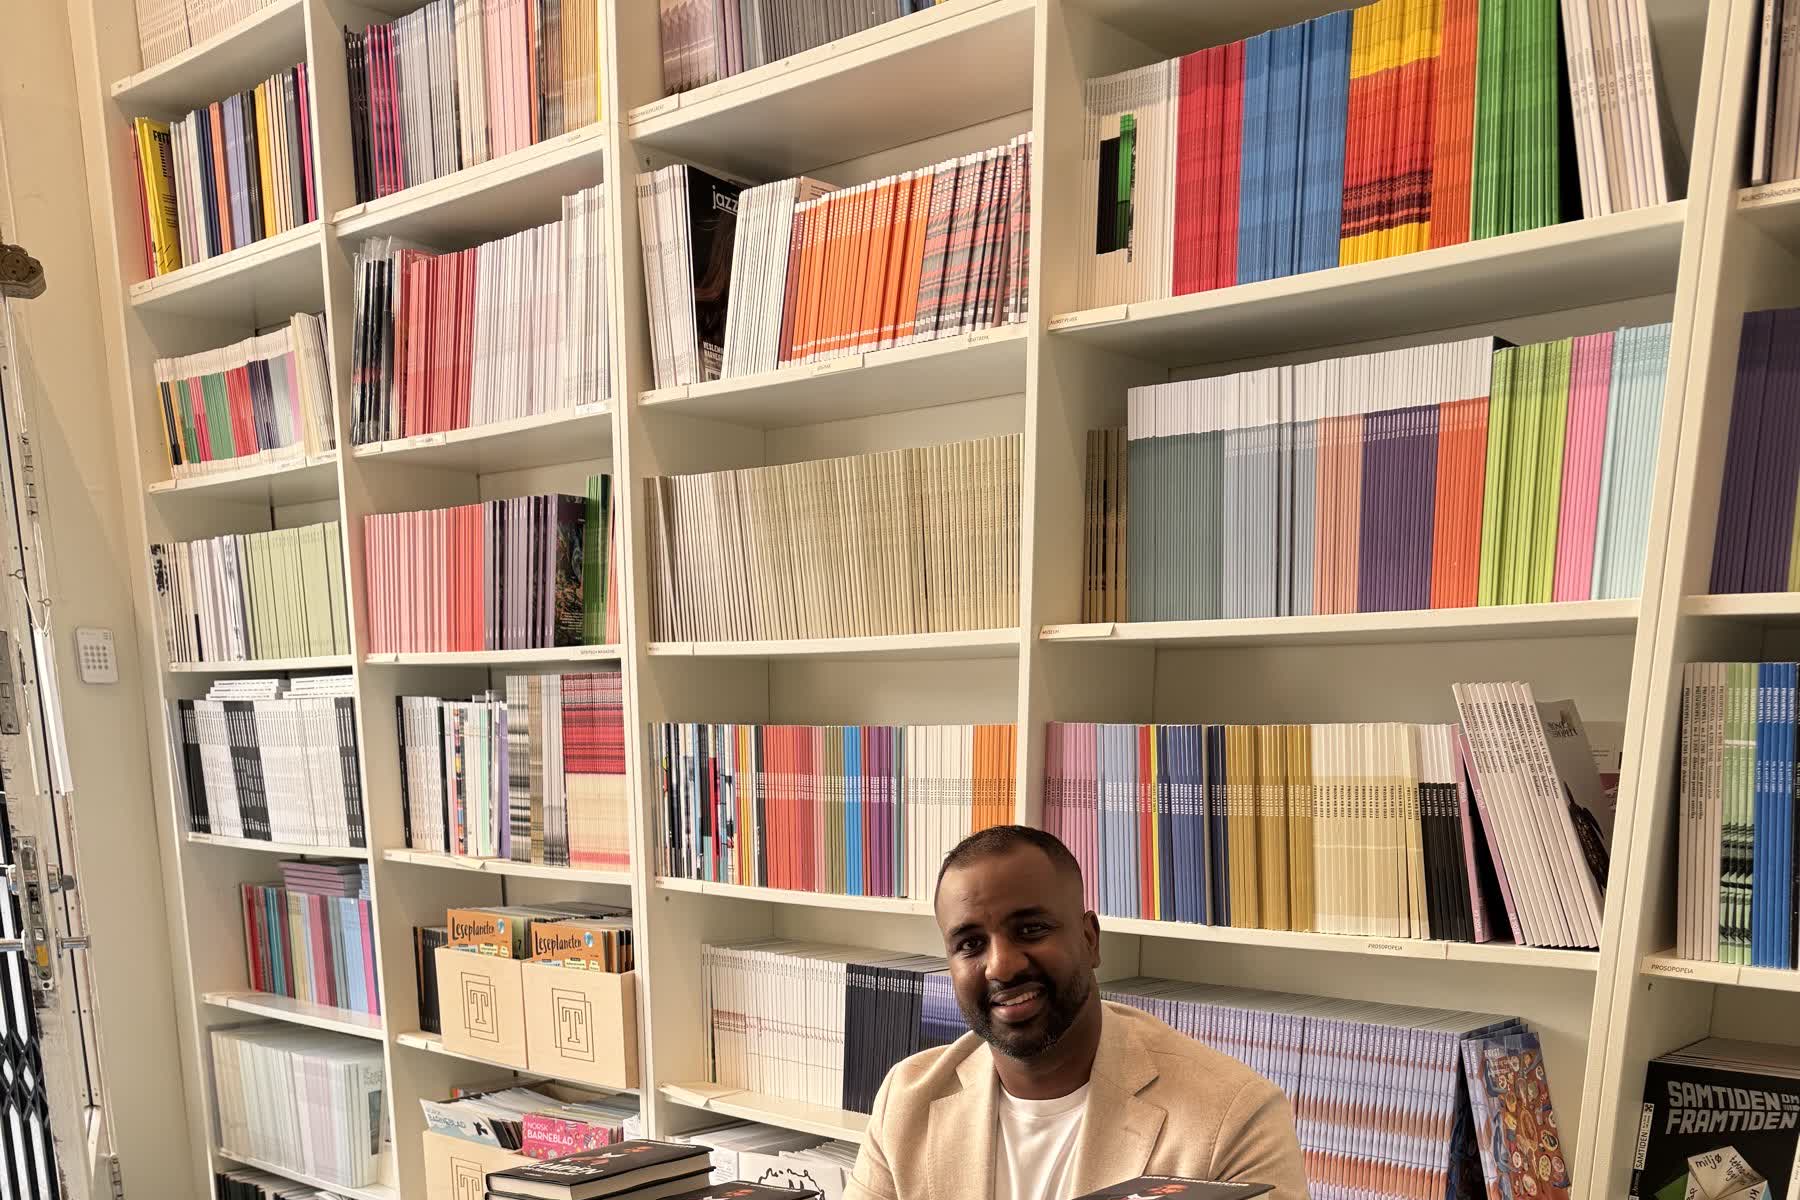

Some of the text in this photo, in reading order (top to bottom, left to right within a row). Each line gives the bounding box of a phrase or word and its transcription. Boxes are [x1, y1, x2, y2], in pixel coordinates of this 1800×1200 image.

[452, 917, 495, 941] Leseplaneten
[535, 931, 582, 956] Leseplaneten
[470, 989, 489, 1024] T
[562, 1006, 584, 1044] T
[1667, 1080, 1781, 1111] SAMTIDEN
[527, 1122, 548, 1133] NORSK
[1665, 1108, 1799, 1135] FRAMTIDEN
[527, 1129, 574, 1146] BARNEBLAD
[1636, 1131, 1648, 1169] SAMTIDEN
[1695, 1153, 1722, 1170] miljø
